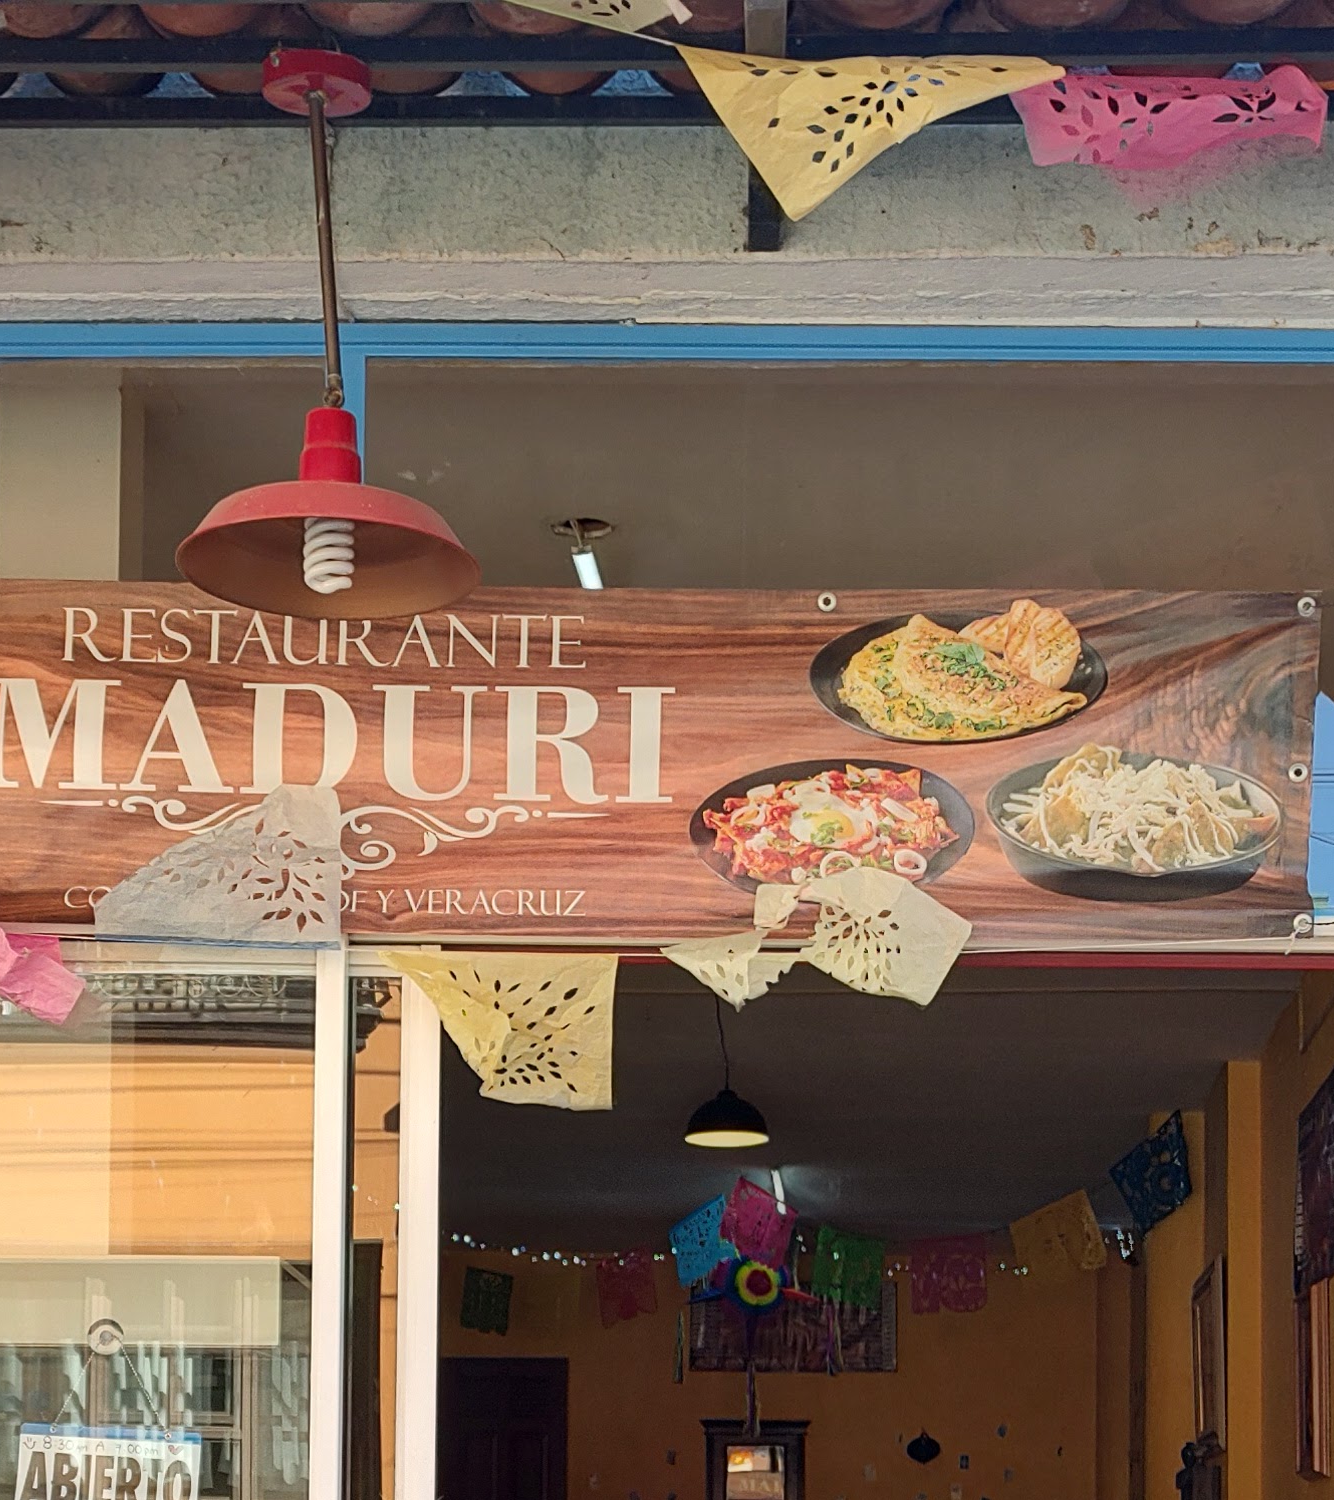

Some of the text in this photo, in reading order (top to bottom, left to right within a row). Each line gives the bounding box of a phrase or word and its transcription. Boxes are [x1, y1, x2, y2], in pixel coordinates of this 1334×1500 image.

[61, 606, 587, 670] RESTAURANTE
[376, 888, 395, 914] Y
[404, 888, 586, 918] VERACRUZ
[95, 1440, 105, 1452] A
